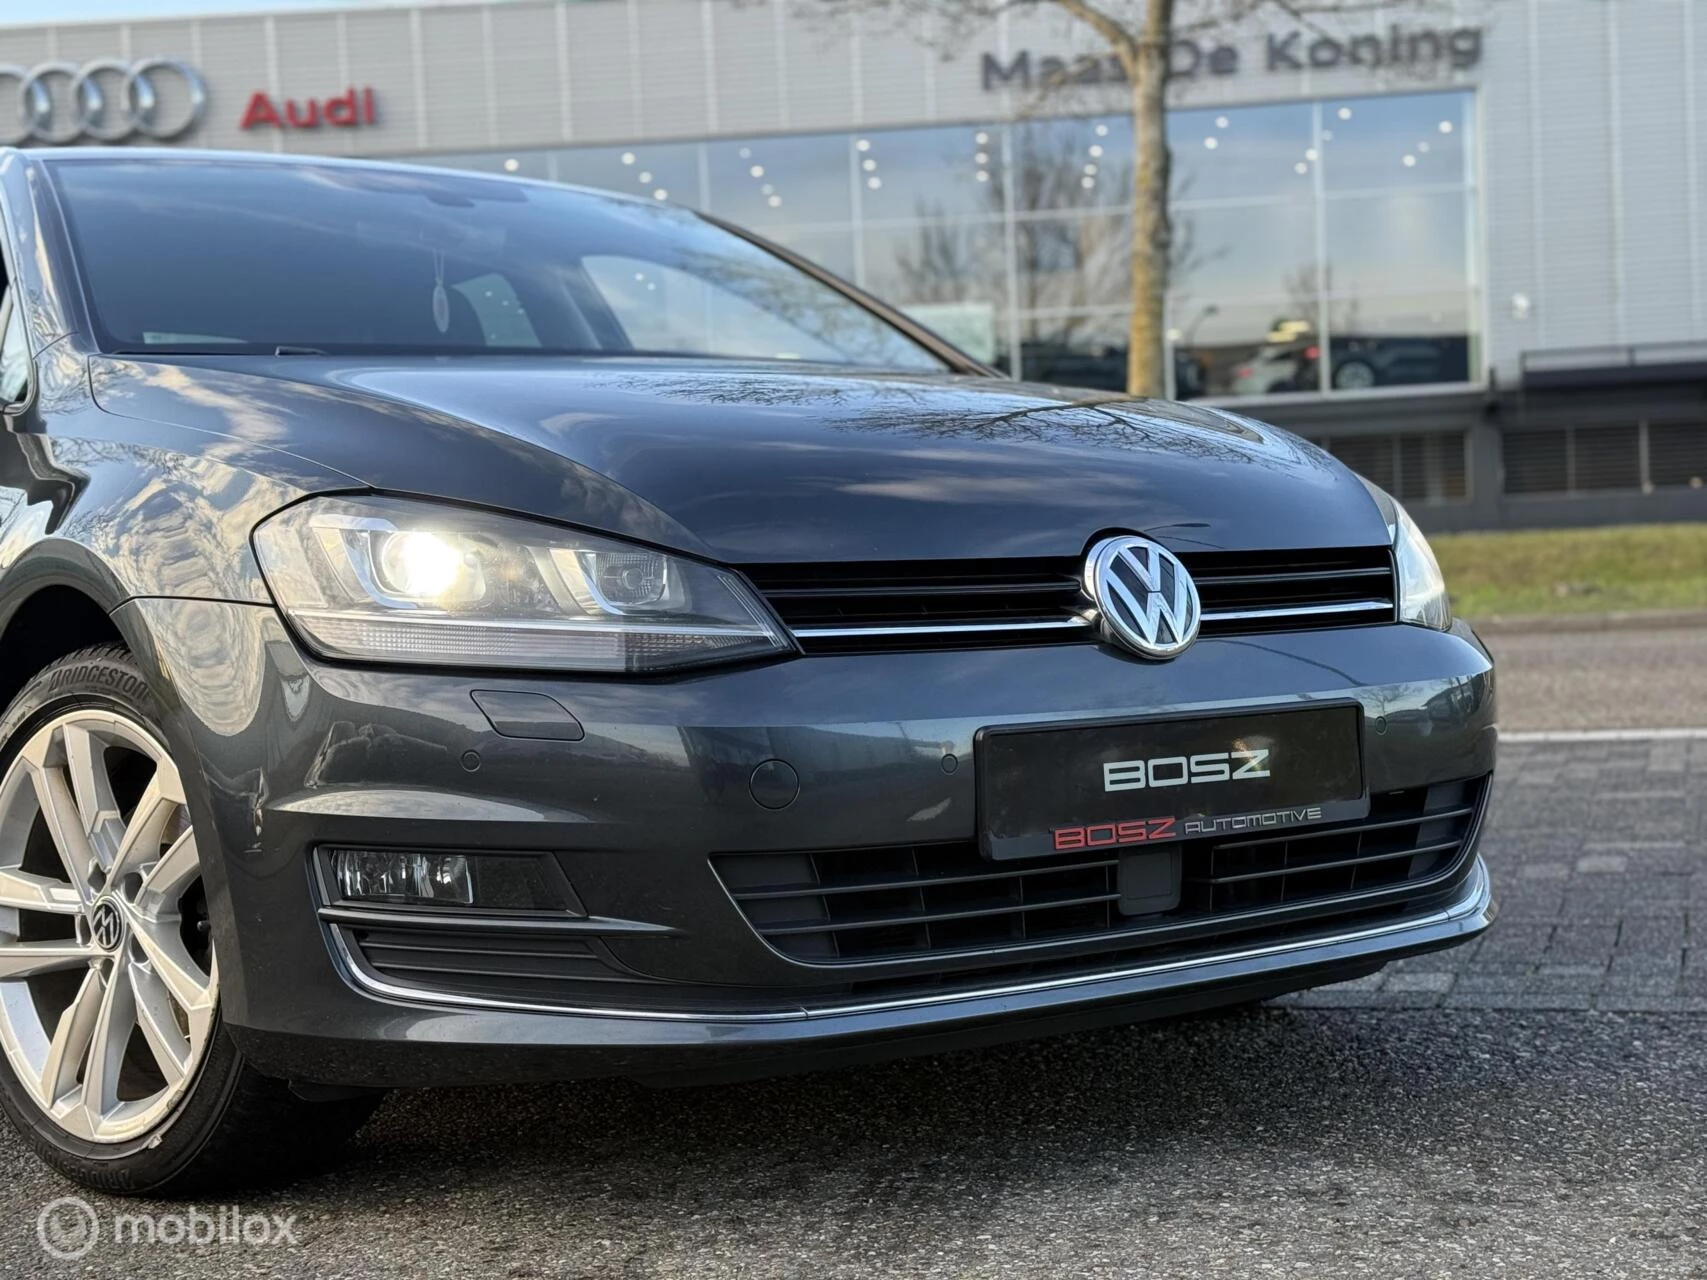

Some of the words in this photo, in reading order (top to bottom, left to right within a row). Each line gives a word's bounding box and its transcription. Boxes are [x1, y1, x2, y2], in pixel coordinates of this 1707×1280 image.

[1267, 27, 1484, 71] Koning
[239, 85, 377, 131] Audi
[1104, 749, 1271, 792] BOSZ
[1054, 817, 1177, 850] BOSZ
[1184, 808, 1322, 834] AUTOMOTIVE
